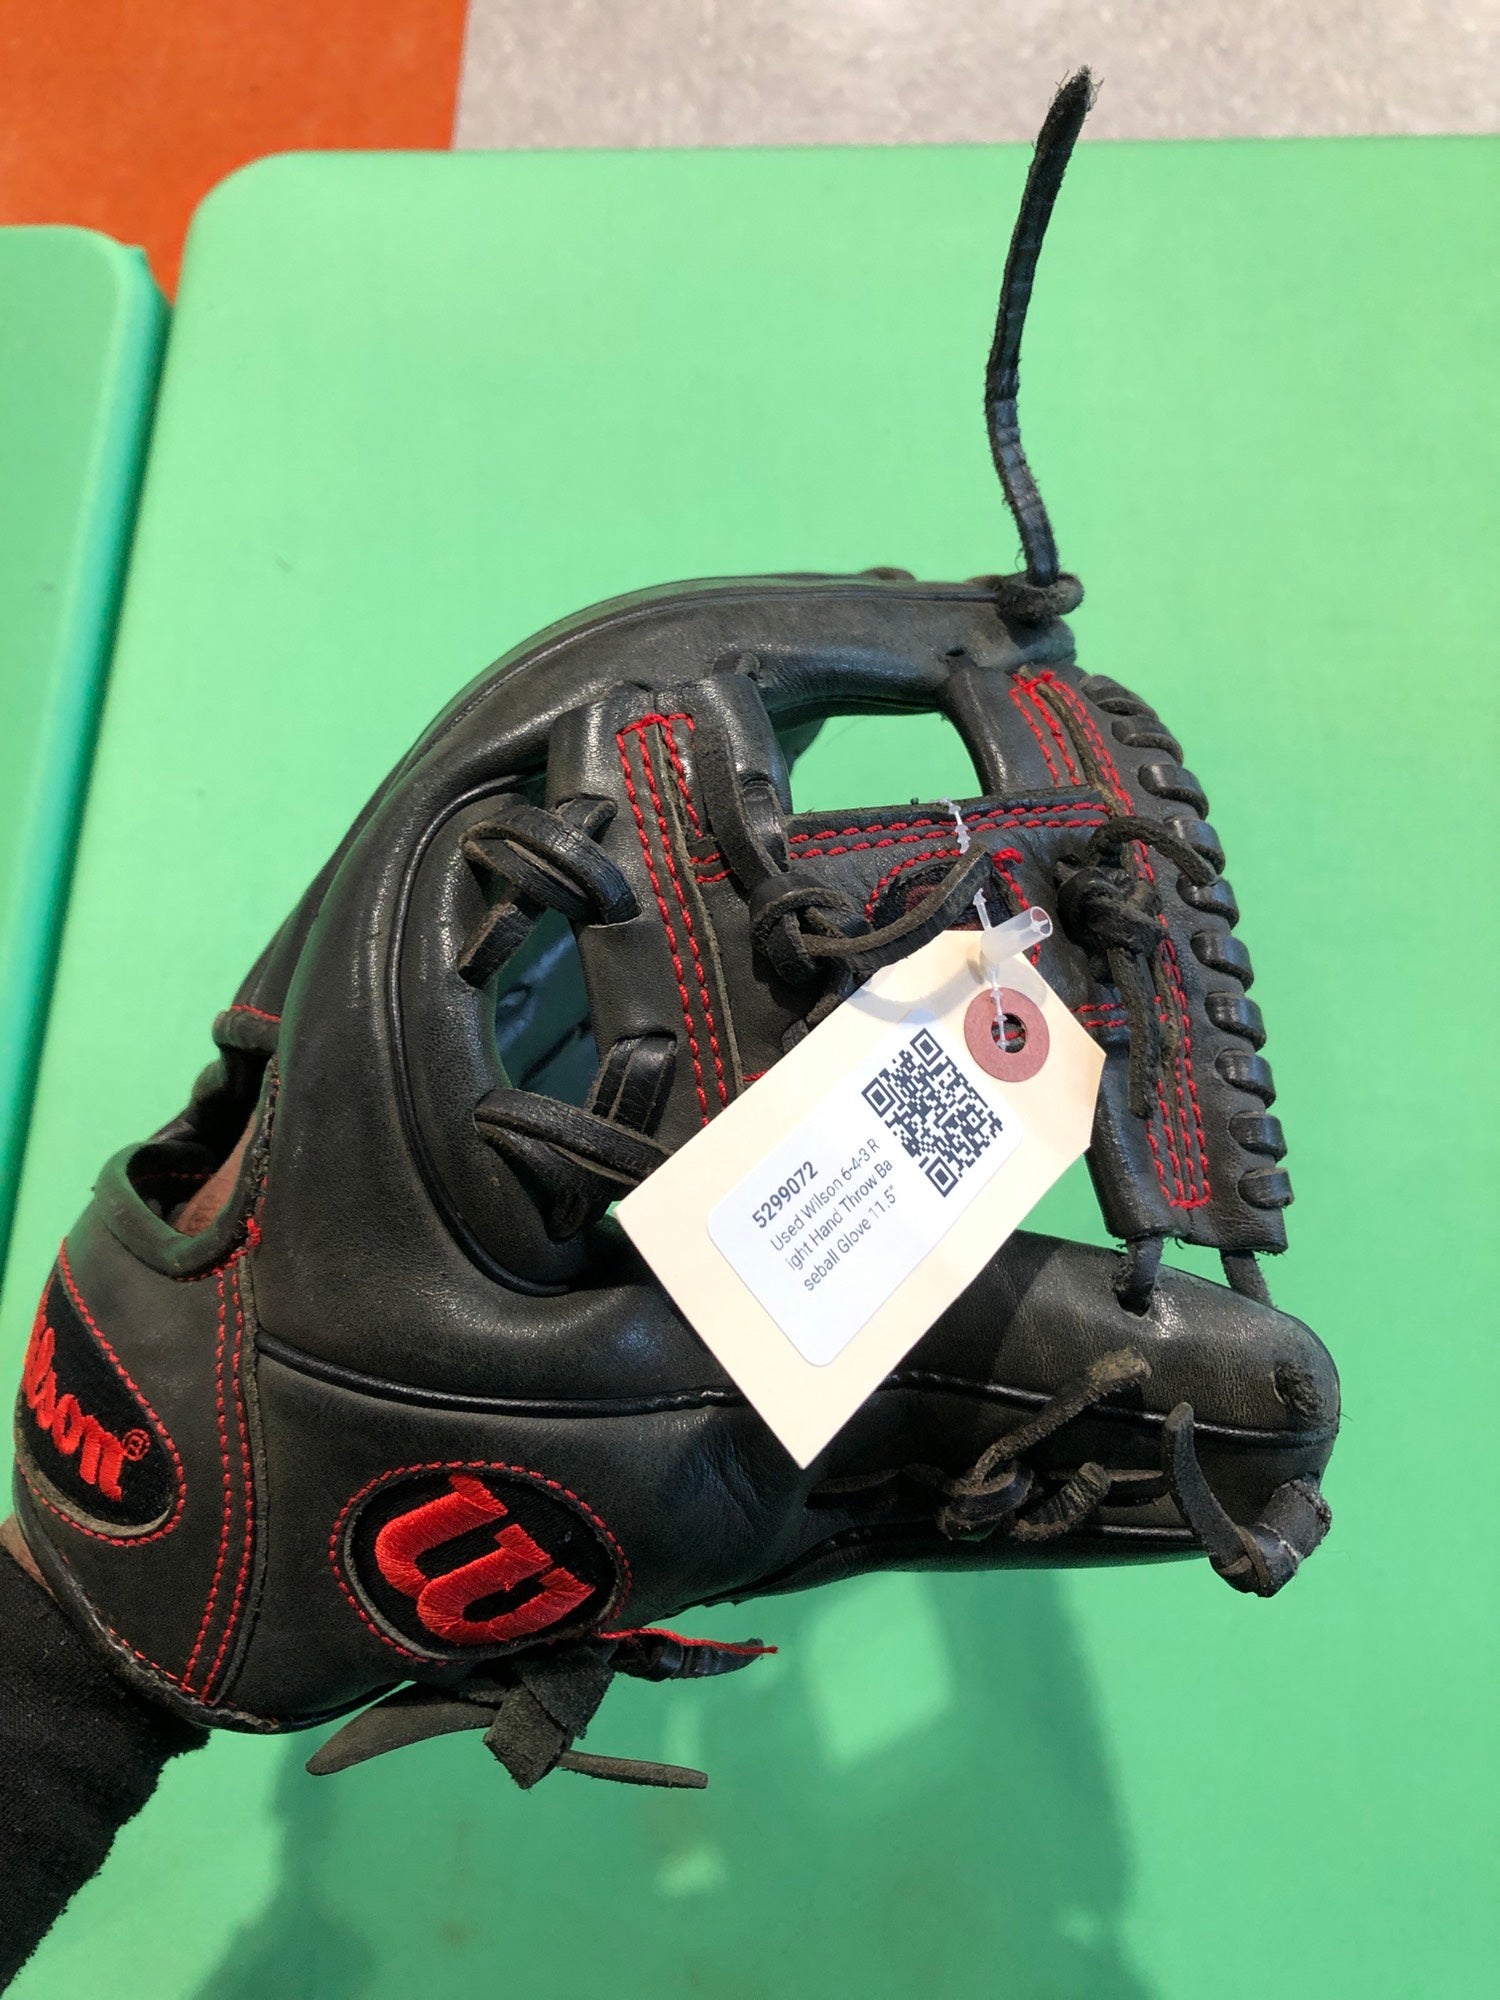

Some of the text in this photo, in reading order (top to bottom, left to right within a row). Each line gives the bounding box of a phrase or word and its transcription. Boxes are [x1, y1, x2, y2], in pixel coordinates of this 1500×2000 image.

[752, 1160, 818, 1229] 5299072
[770, 1138, 880, 1251] Used Wilson 6-4-3 R
[785, 1159, 893, 1271] ight Hand Throw Ba
[803, 1184, 896, 1291] seball Glove 11.5"
